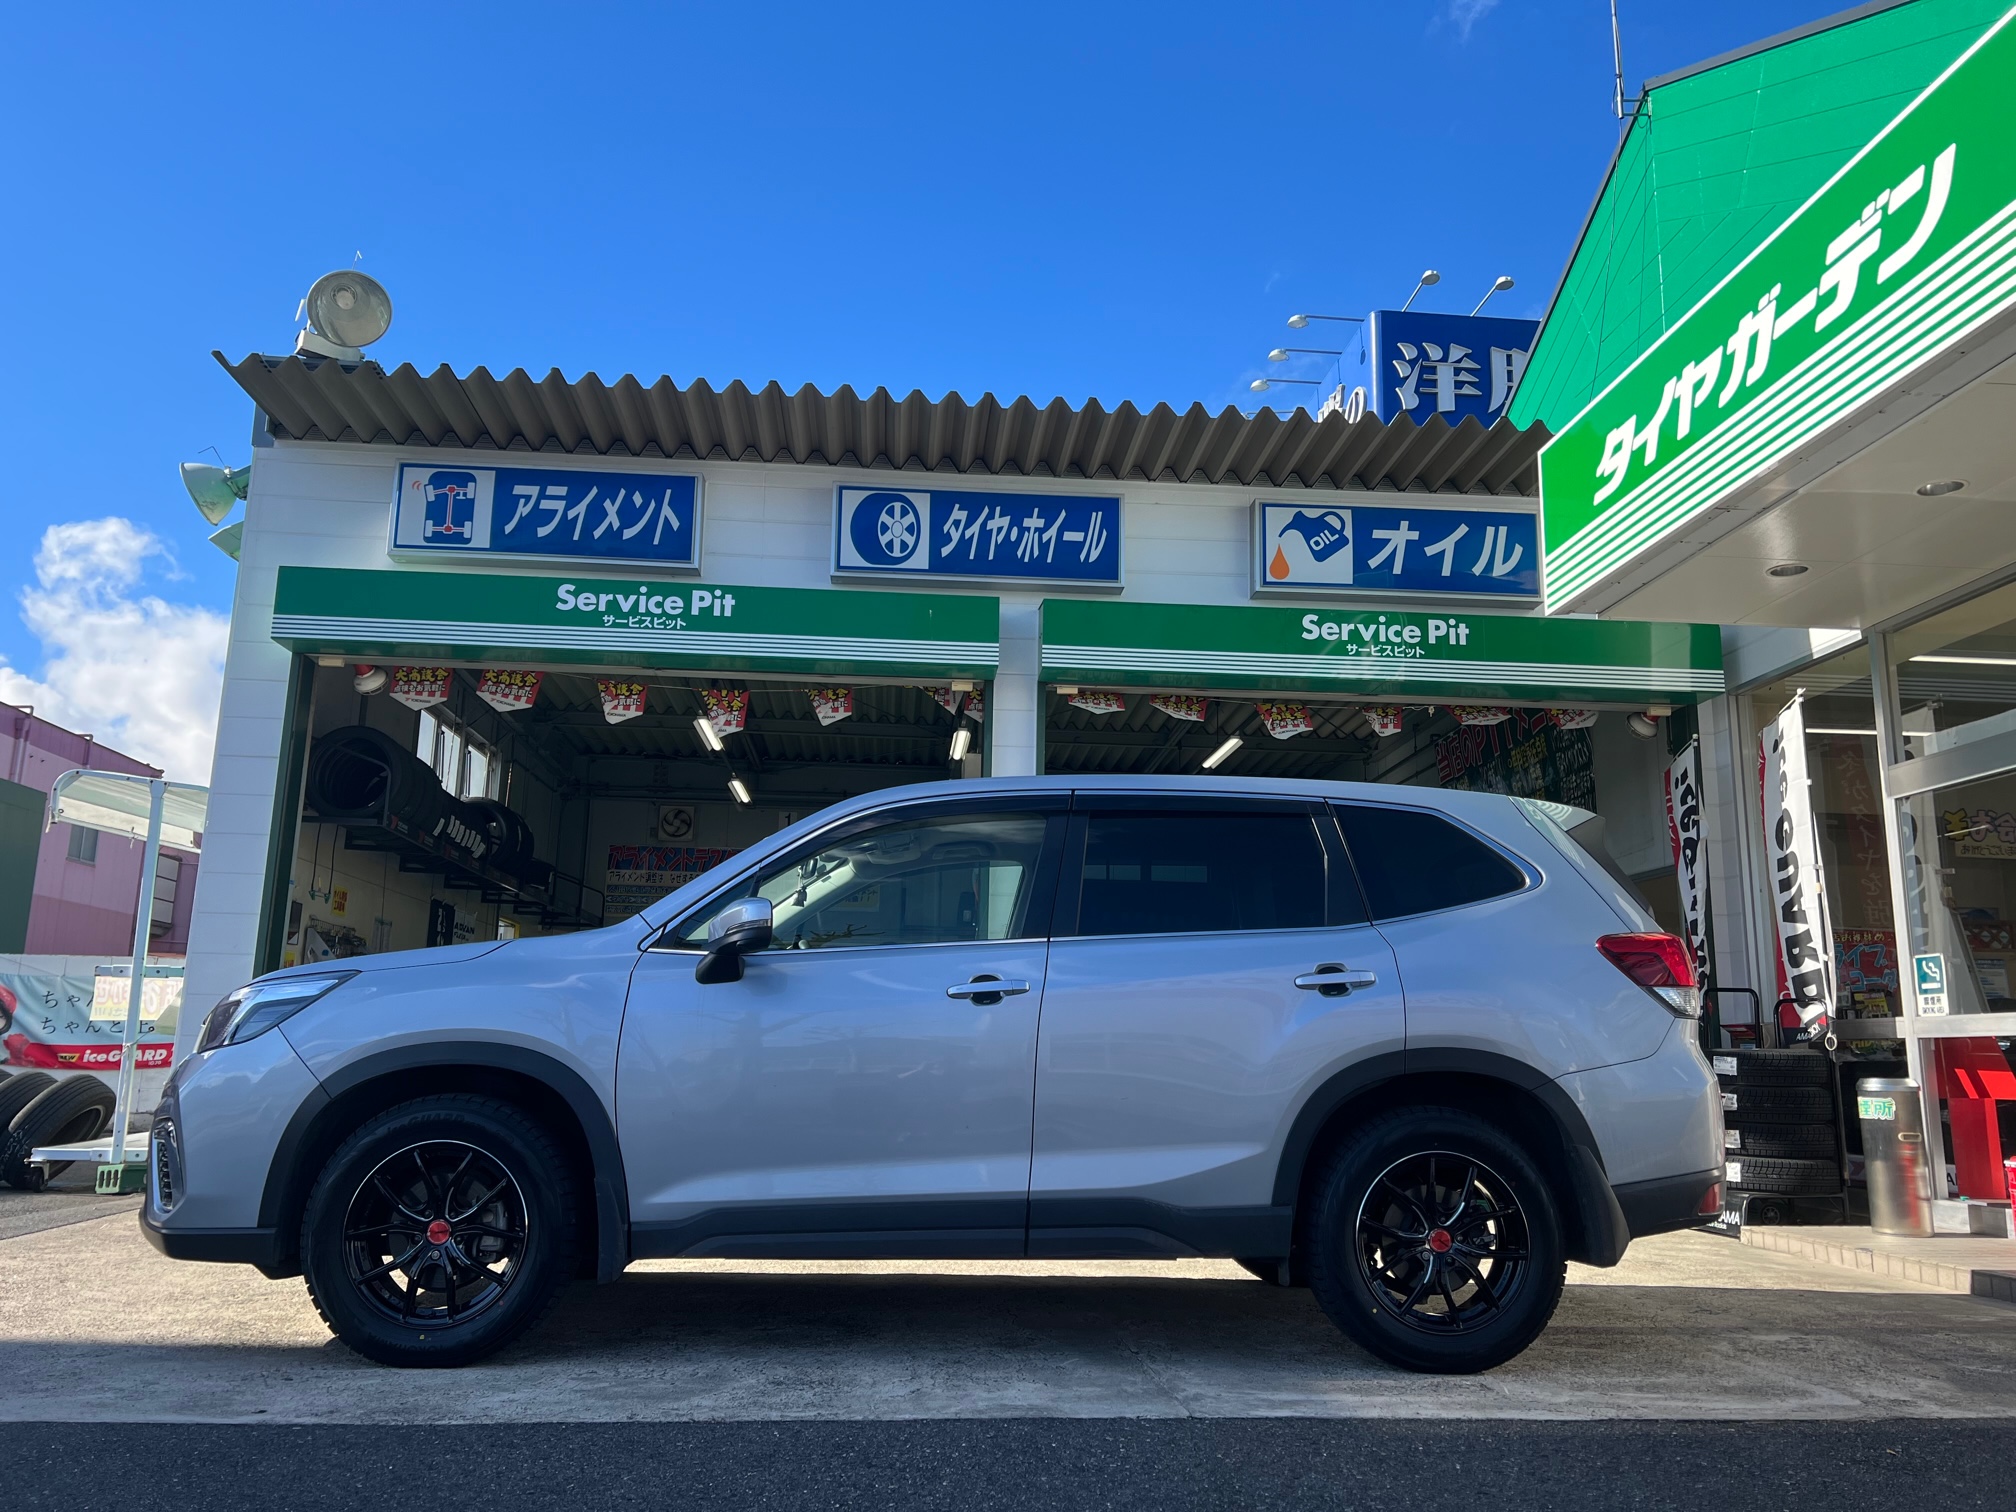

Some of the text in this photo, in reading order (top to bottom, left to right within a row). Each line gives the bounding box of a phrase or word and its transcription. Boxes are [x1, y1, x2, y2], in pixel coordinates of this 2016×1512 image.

[1593, 143, 1956, 506] タイヤガーデン
[504, 485, 680, 545] アライメント
[941, 503, 1107, 563] タイヤ・ホイール
[1309, 529, 1340, 551] OIL
[1367, 520, 1523, 577] オイル
[555, 583, 736, 617] Service Pit
[602, 615, 686, 630] サービスピット
[1301, 614, 1469, 645] Service Pit
[1346, 644, 1425, 658] サービスピット
[82, 1049, 167, 1063] iceGARD
